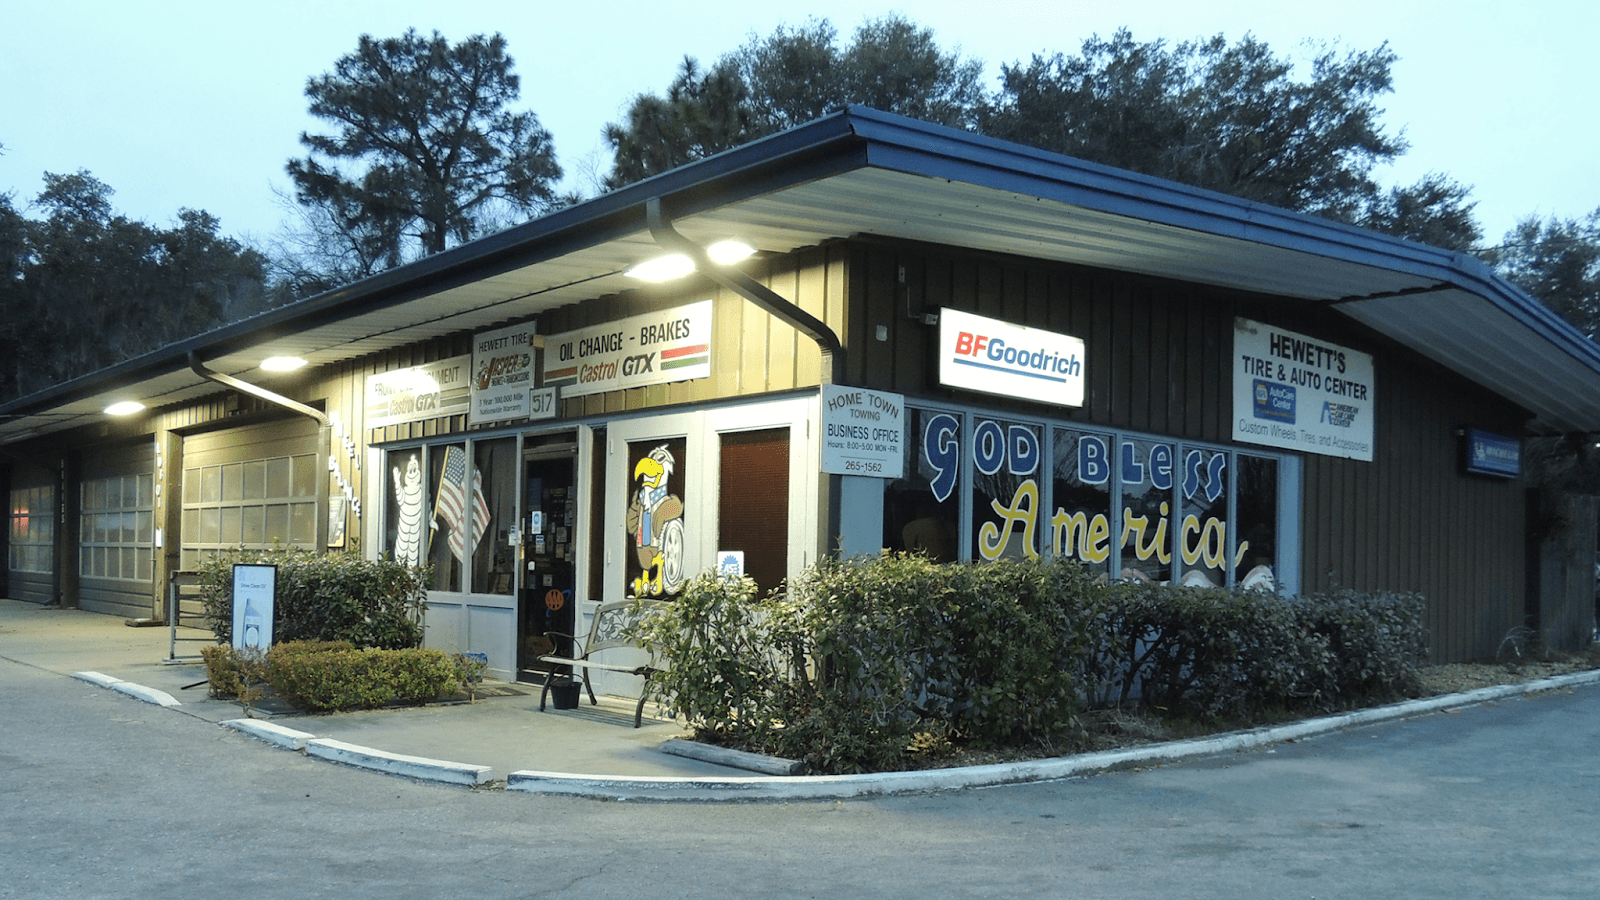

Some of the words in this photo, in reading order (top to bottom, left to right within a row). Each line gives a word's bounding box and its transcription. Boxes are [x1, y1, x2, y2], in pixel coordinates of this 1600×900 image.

[479, 337, 508, 353] HEWETT
[511, 332, 528, 346] TIRE
[559, 343, 575, 361] OIL
[579, 332, 623, 357] CHANGE
[640, 318, 690, 346] BRAKES
[955, 331, 1081, 377] BFGoodrich
[1270, 332, 1346, 374] HEWETT'S
[480, 355, 519, 390] JASPER
[580, 359, 619, 384] Castrol
[622, 352, 656, 376] GTX
[1242, 355, 1273, 378] TIRE
[1277, 364, 1286, 381] &
[1290, 367, 1321, 390] AUTO
[1325, 376, 1367, 400] CENTER
[390, 396, 415, 416] Castrol
[415, 392, 438, 411] GTX
[533, 393, 553, 413] 517
[828, 393, 862, 411] HOME
[868, 394, 899, 418] TOWN
[850, 409, 880, 420] TOWING
[828, 424, 869, 440] BUSINESS
[873, 428, 898, 443] OFFICE
[828, 440, 844, 449] Hours:
[1239, 418, 1268, 437] Custom
[1319, 435, 1330, 447] and
[1332, 436, 1369, 453] Accessories
[846, 461, 882, 473] 265-1562
[924, 413, 1039, 502] GOD
[979, 479, 1248, 571] America
